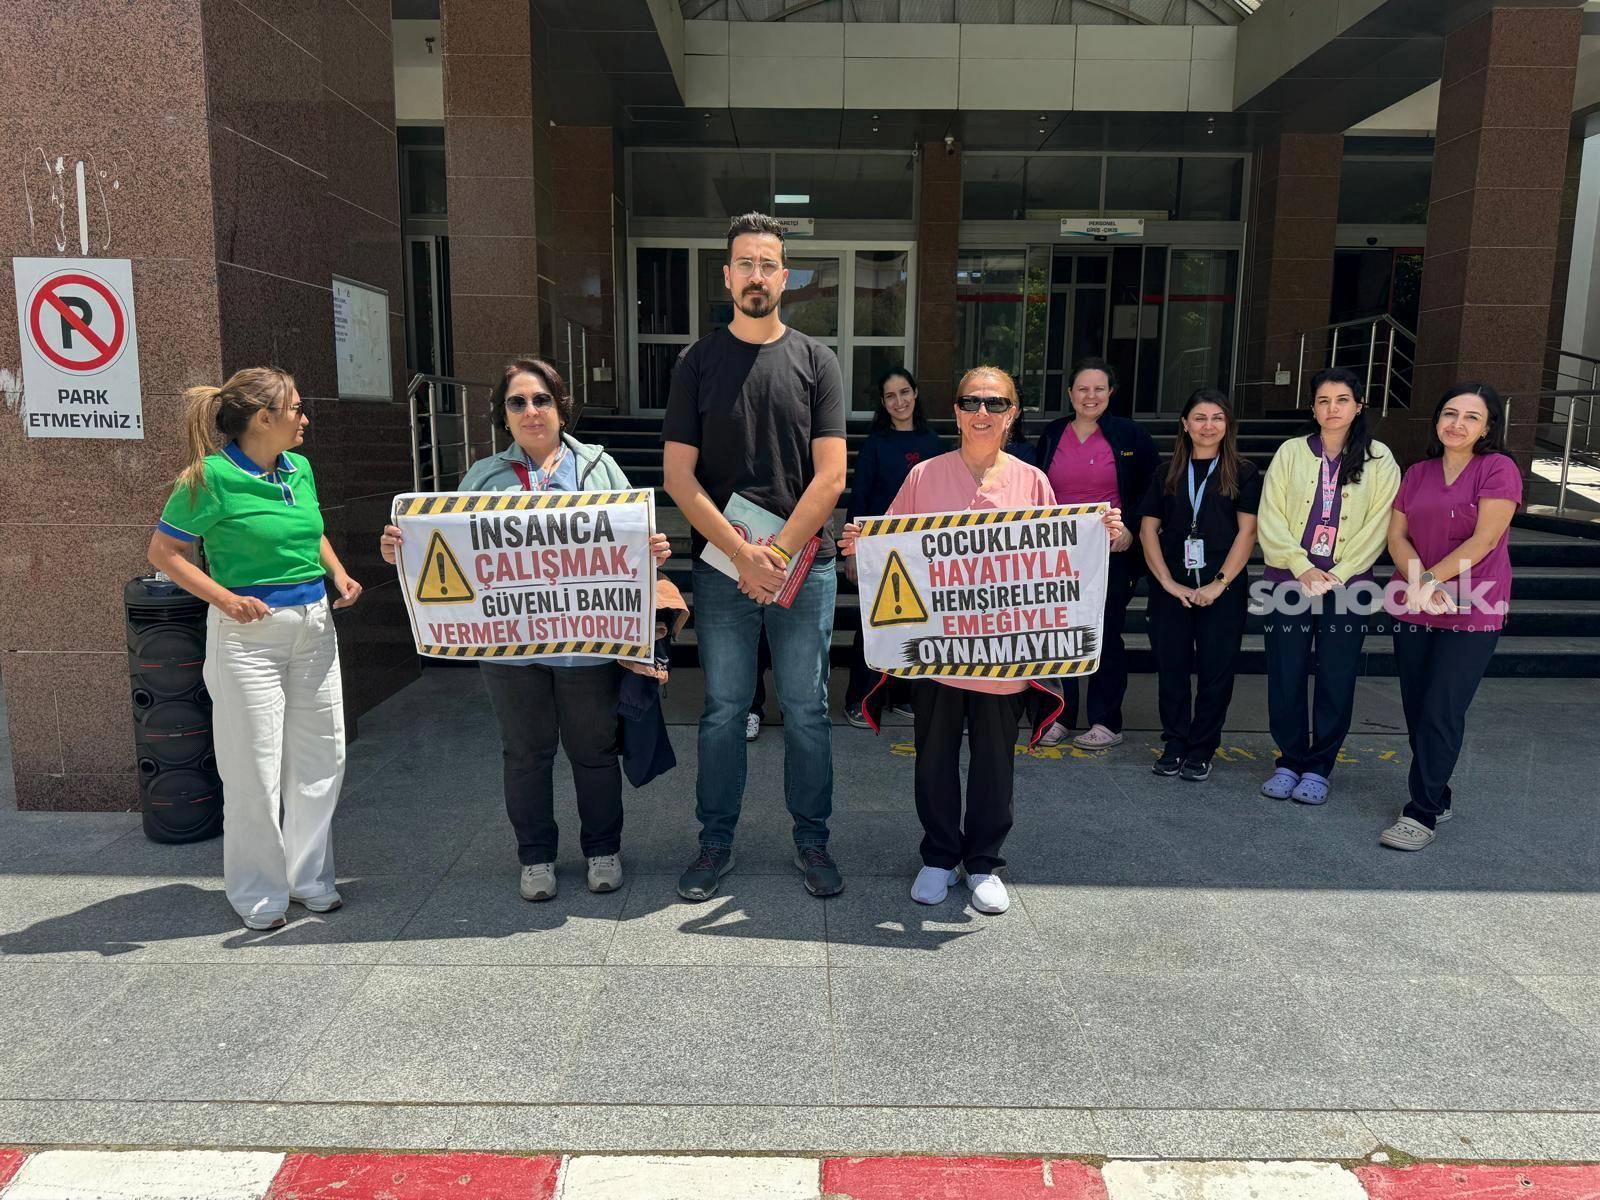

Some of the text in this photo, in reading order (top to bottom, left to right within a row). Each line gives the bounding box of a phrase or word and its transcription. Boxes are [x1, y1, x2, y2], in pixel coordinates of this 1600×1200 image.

[57, 389, 109, 405] PARK
[29, 410, 131, 429] ETMEYİNİZ
[469, 510, 615, 551] İNSANCA
[921, 519, 1078, 563] ÇOCUKLARIN
[474, 544, 638, 591] ÇALIŞMAK,
[928, 549, 1080, 588] HAYATIYLA,
[482, 588, 642, 618] GÜVENLİ BAKIM
[932, 579, 1081, 613] HEMŞİRELERİN
[428, 612, 642, 645] VERMEK İSTİYORUZ!
[942, 606, 1069, 636] EMEĞİYLE
[917, 629, 1084, 665] OYNAMAYIN!
